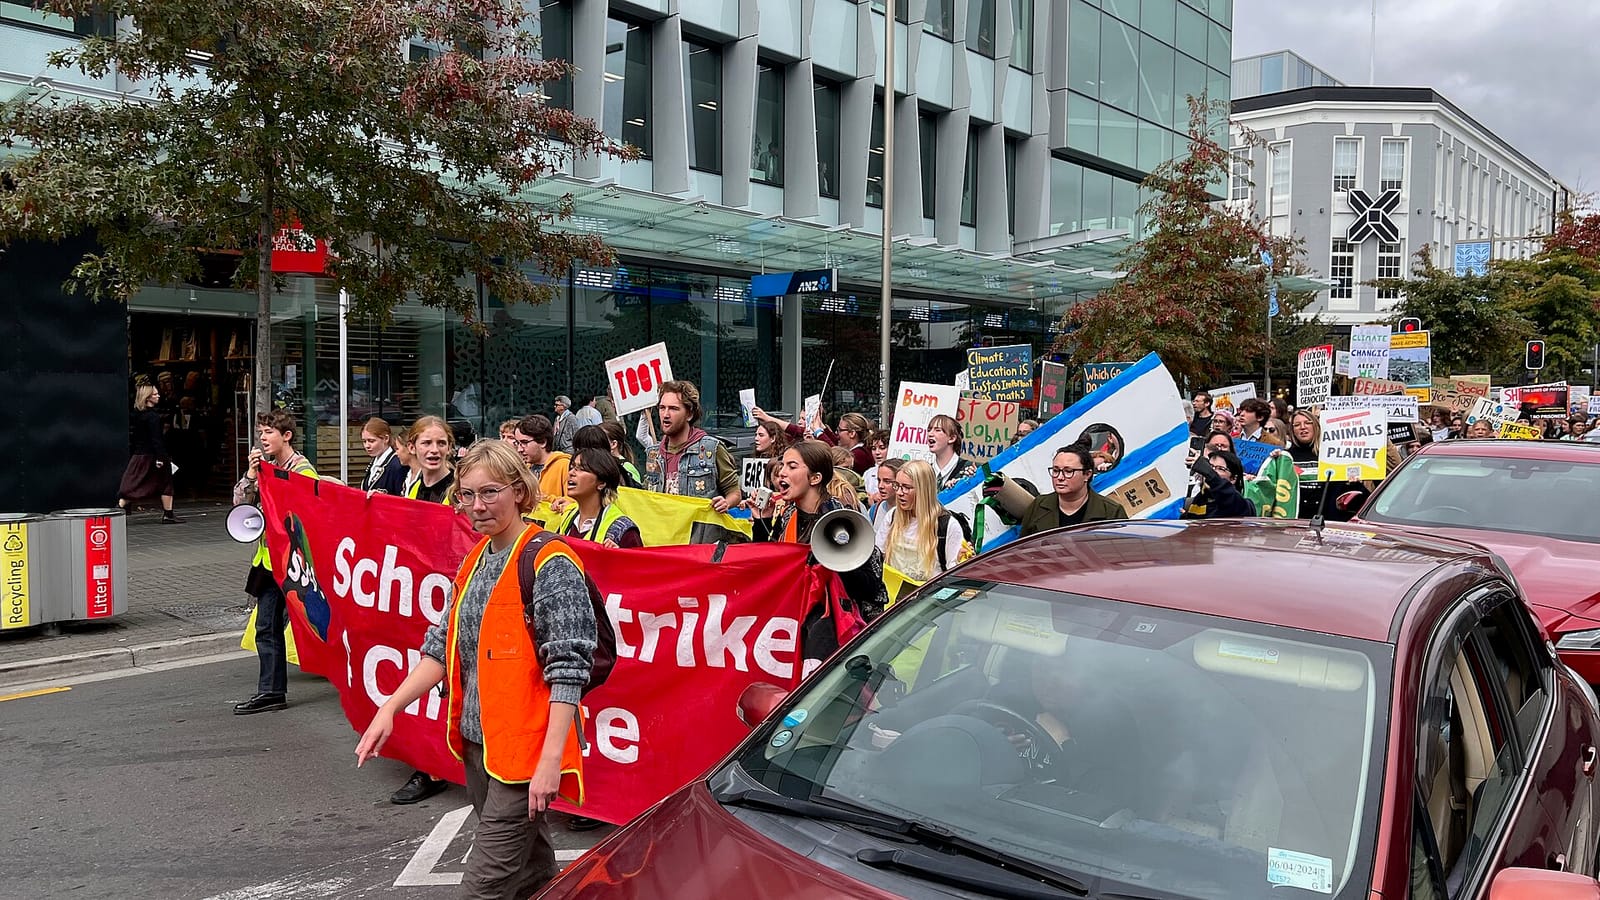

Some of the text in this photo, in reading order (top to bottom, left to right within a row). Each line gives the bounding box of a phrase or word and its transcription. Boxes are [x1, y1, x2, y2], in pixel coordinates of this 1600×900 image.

[574, 270, 613, 288] ANZ
[797, 281, 818, 292] ANZ
[1304, 351, 1326, 360] LUXON
[1304, 359, 1326, 369] LUXON
[970, 365, 1017, 379] Education
[1083, 366, 1110, 382] Which
[1299, 367, 1328, 378] YOU CAN'T
[614, 358, 663, 400] TOOT
[1314, 376, 1330, 385] YOUR
[1086, 382, 1097, 394] Do
[1300, 385, 1328, 396] SILENCE IS
[1456, 380, 1489, 397] Social
[1393, 407, 1414, 417] ALL
[1322, 424, 1383, 442] ANIMALS
[1327, 447, 1378, 459] PLANET
[9, 559, 25, 623] Recycling
[93, 580, 108, 614] Litter
[1269, 860, 1318, 876] 06/04/2024
